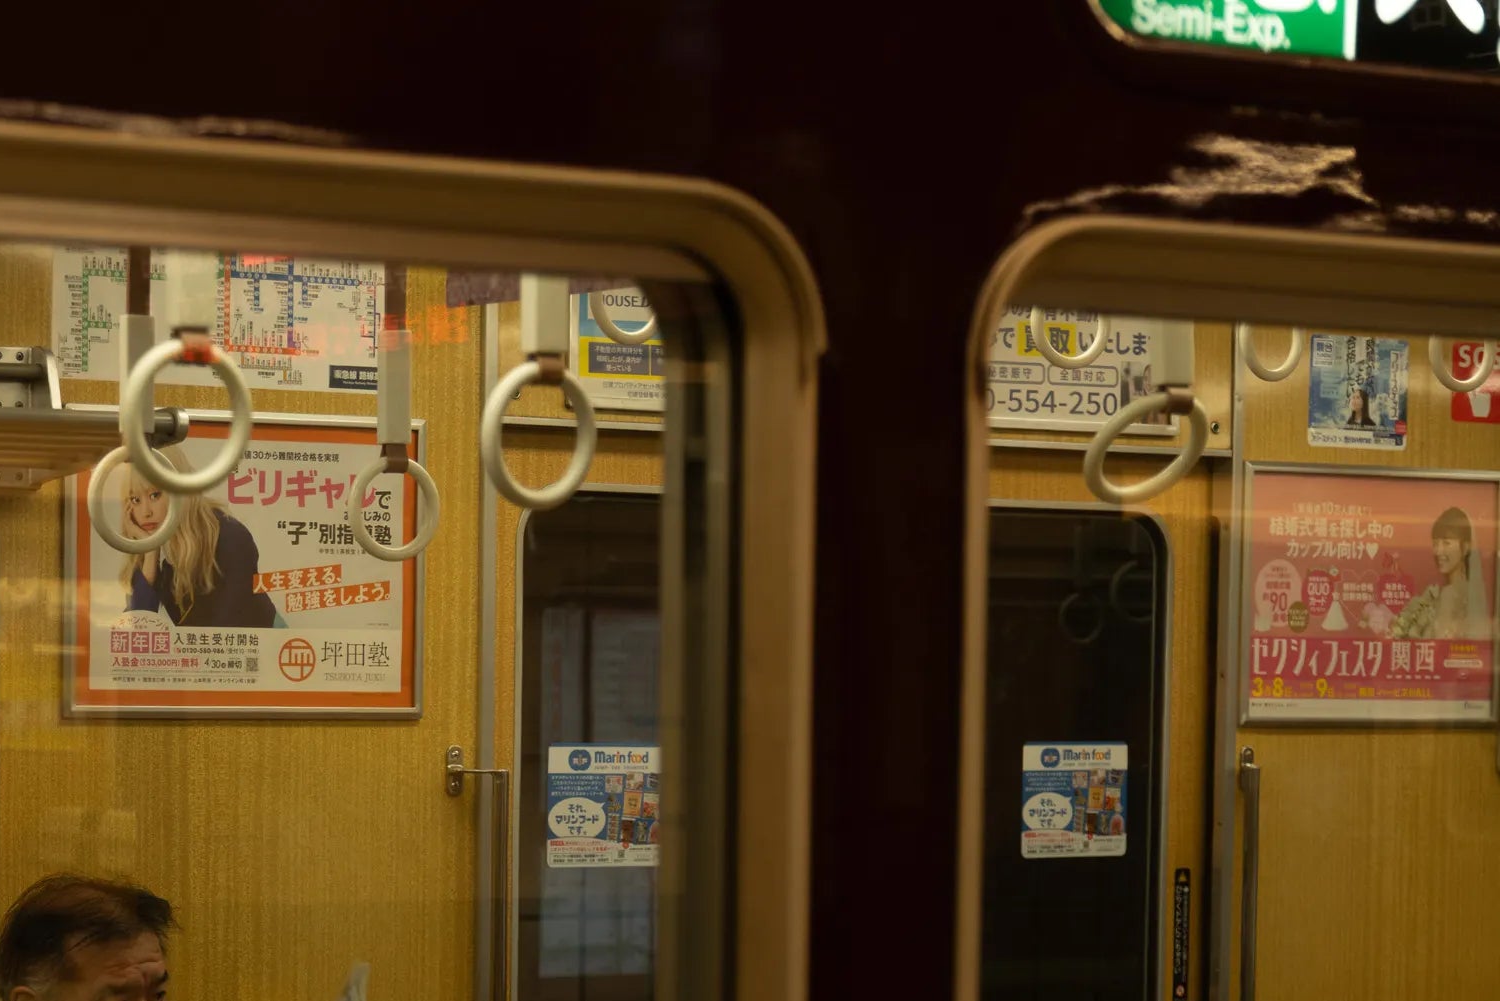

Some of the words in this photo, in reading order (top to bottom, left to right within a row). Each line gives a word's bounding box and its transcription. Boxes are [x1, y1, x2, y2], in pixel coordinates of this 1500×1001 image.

[1131, 0, 1291, 52] Semi-Exp.
[1458, 344, 1500, 370] SO
[1059, 370, 1106, 383] 全国対応
[254, 567, 342, 592] 人生変える、
[287, 583, 391, 612] 勉強をしよう。
[111, 632, 170, 653] 新年度
[174, 633, 259, 646] 入塾生受付開始
[321, 642, 389, 668] 坪田塾
[1252, 638, 1383, 677] ゼクシィフェスタ
[1392, 642, 1436, 672] 関西
[594, 751, 626, 764] Marin
[627, 751, 649, 764] food
[1062, 748, 1090, 761] Marin
[1091, 749, 1111, 761] food
[555, 815, 599, 824] マリンフード
[567, 803, 587, 813] それ、
